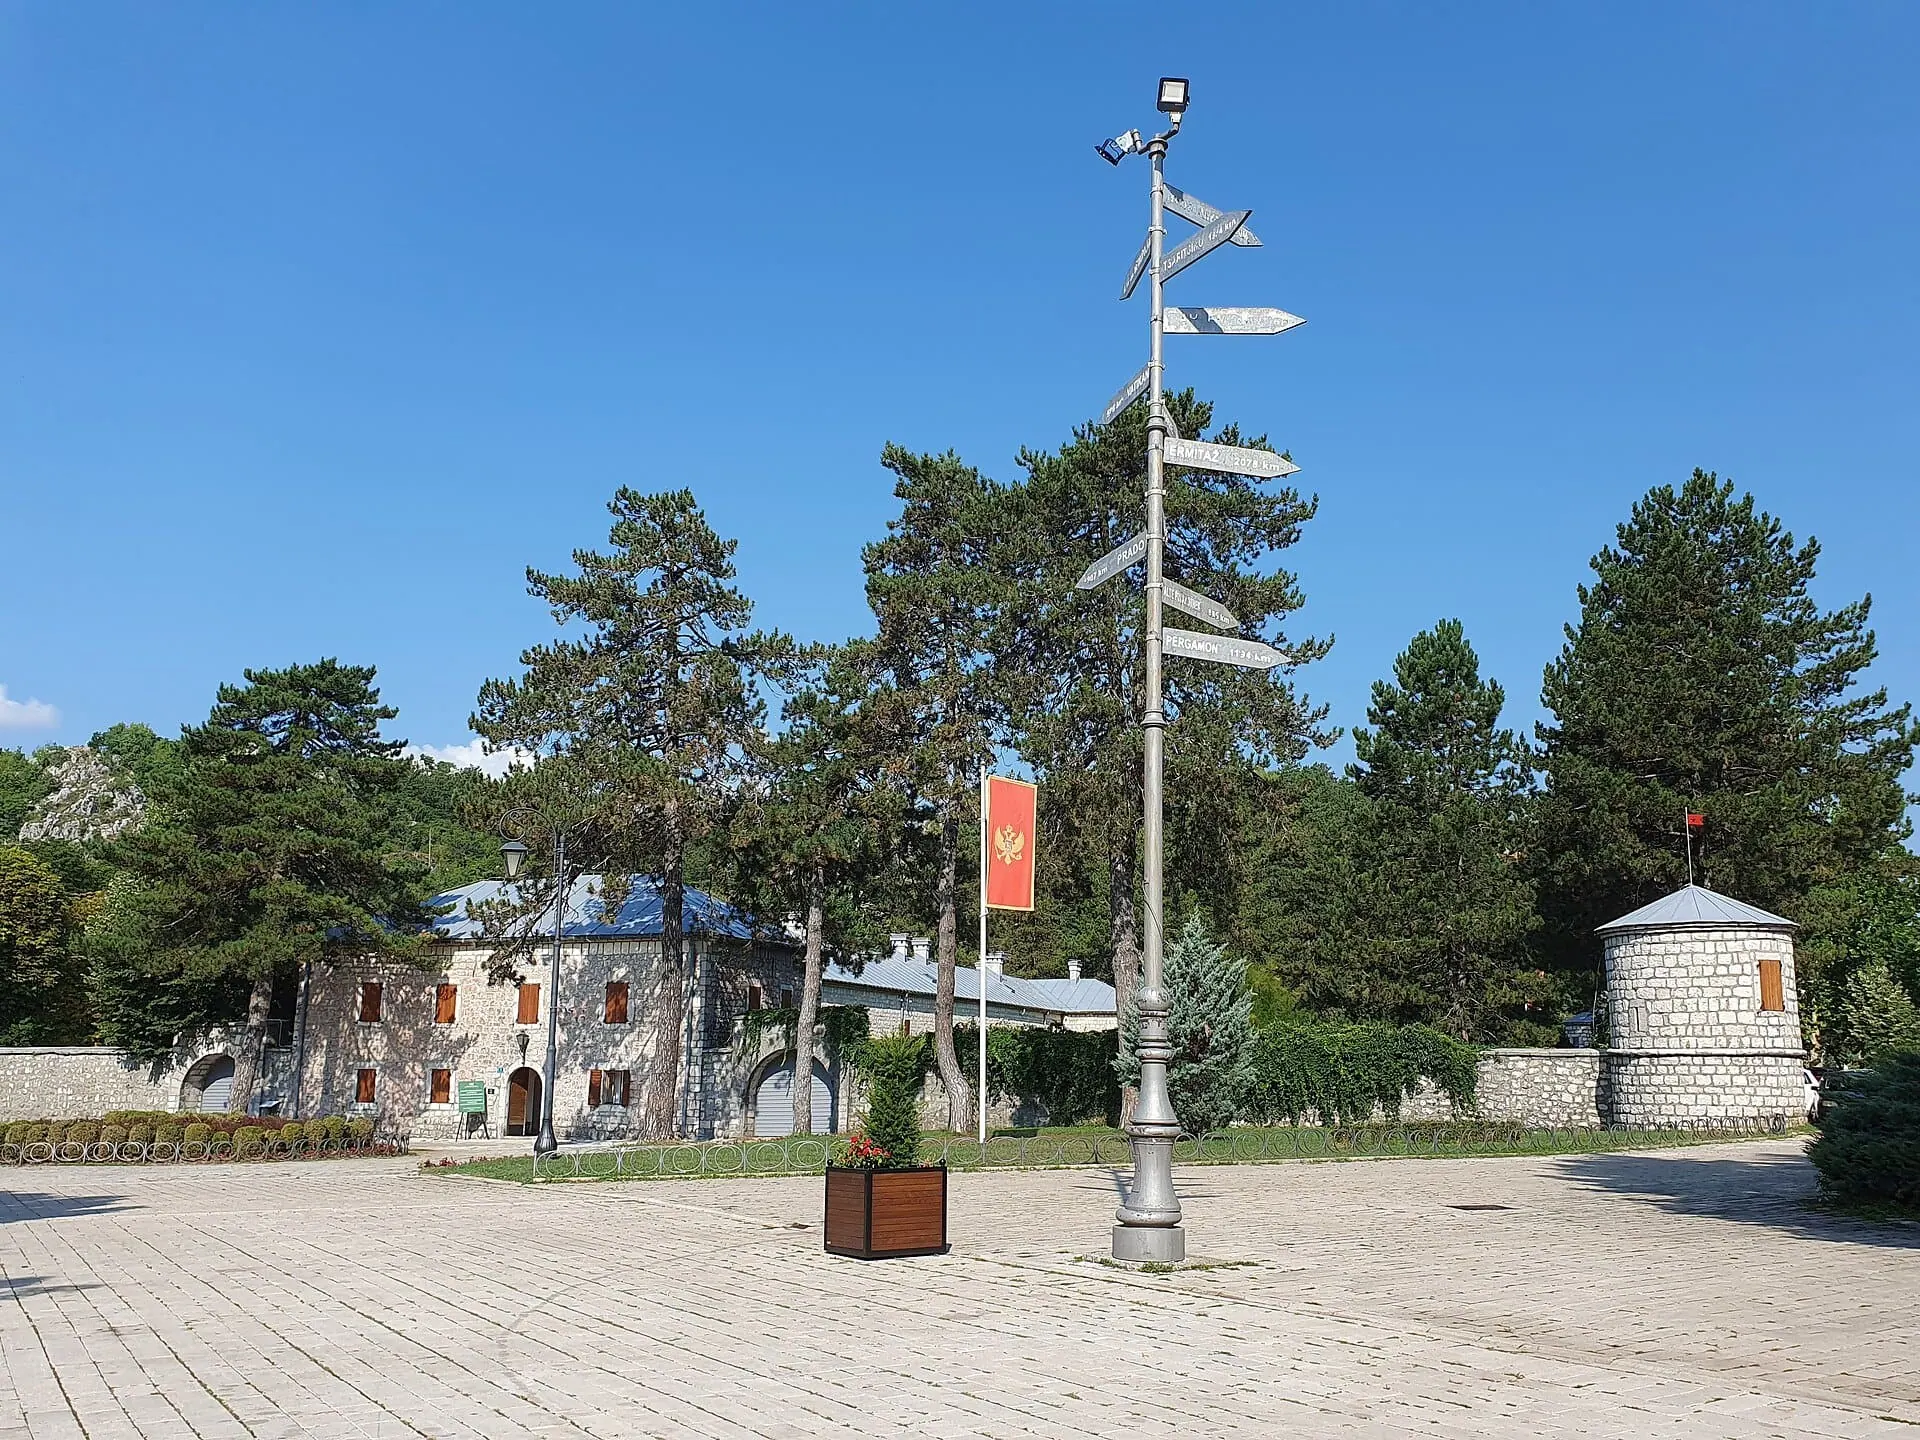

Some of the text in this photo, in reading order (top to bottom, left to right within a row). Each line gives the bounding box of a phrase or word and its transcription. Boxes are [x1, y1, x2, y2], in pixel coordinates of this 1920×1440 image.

[1169, 444, 1280, 472] ERMITAŽ 2078 km
[1117, 539, 1145, 565] PRADO
[1220, 613, 1230, 625] km
[1165, 635, 1219, 654] PERGAMON
[1254, 653, 1272, 664] km
